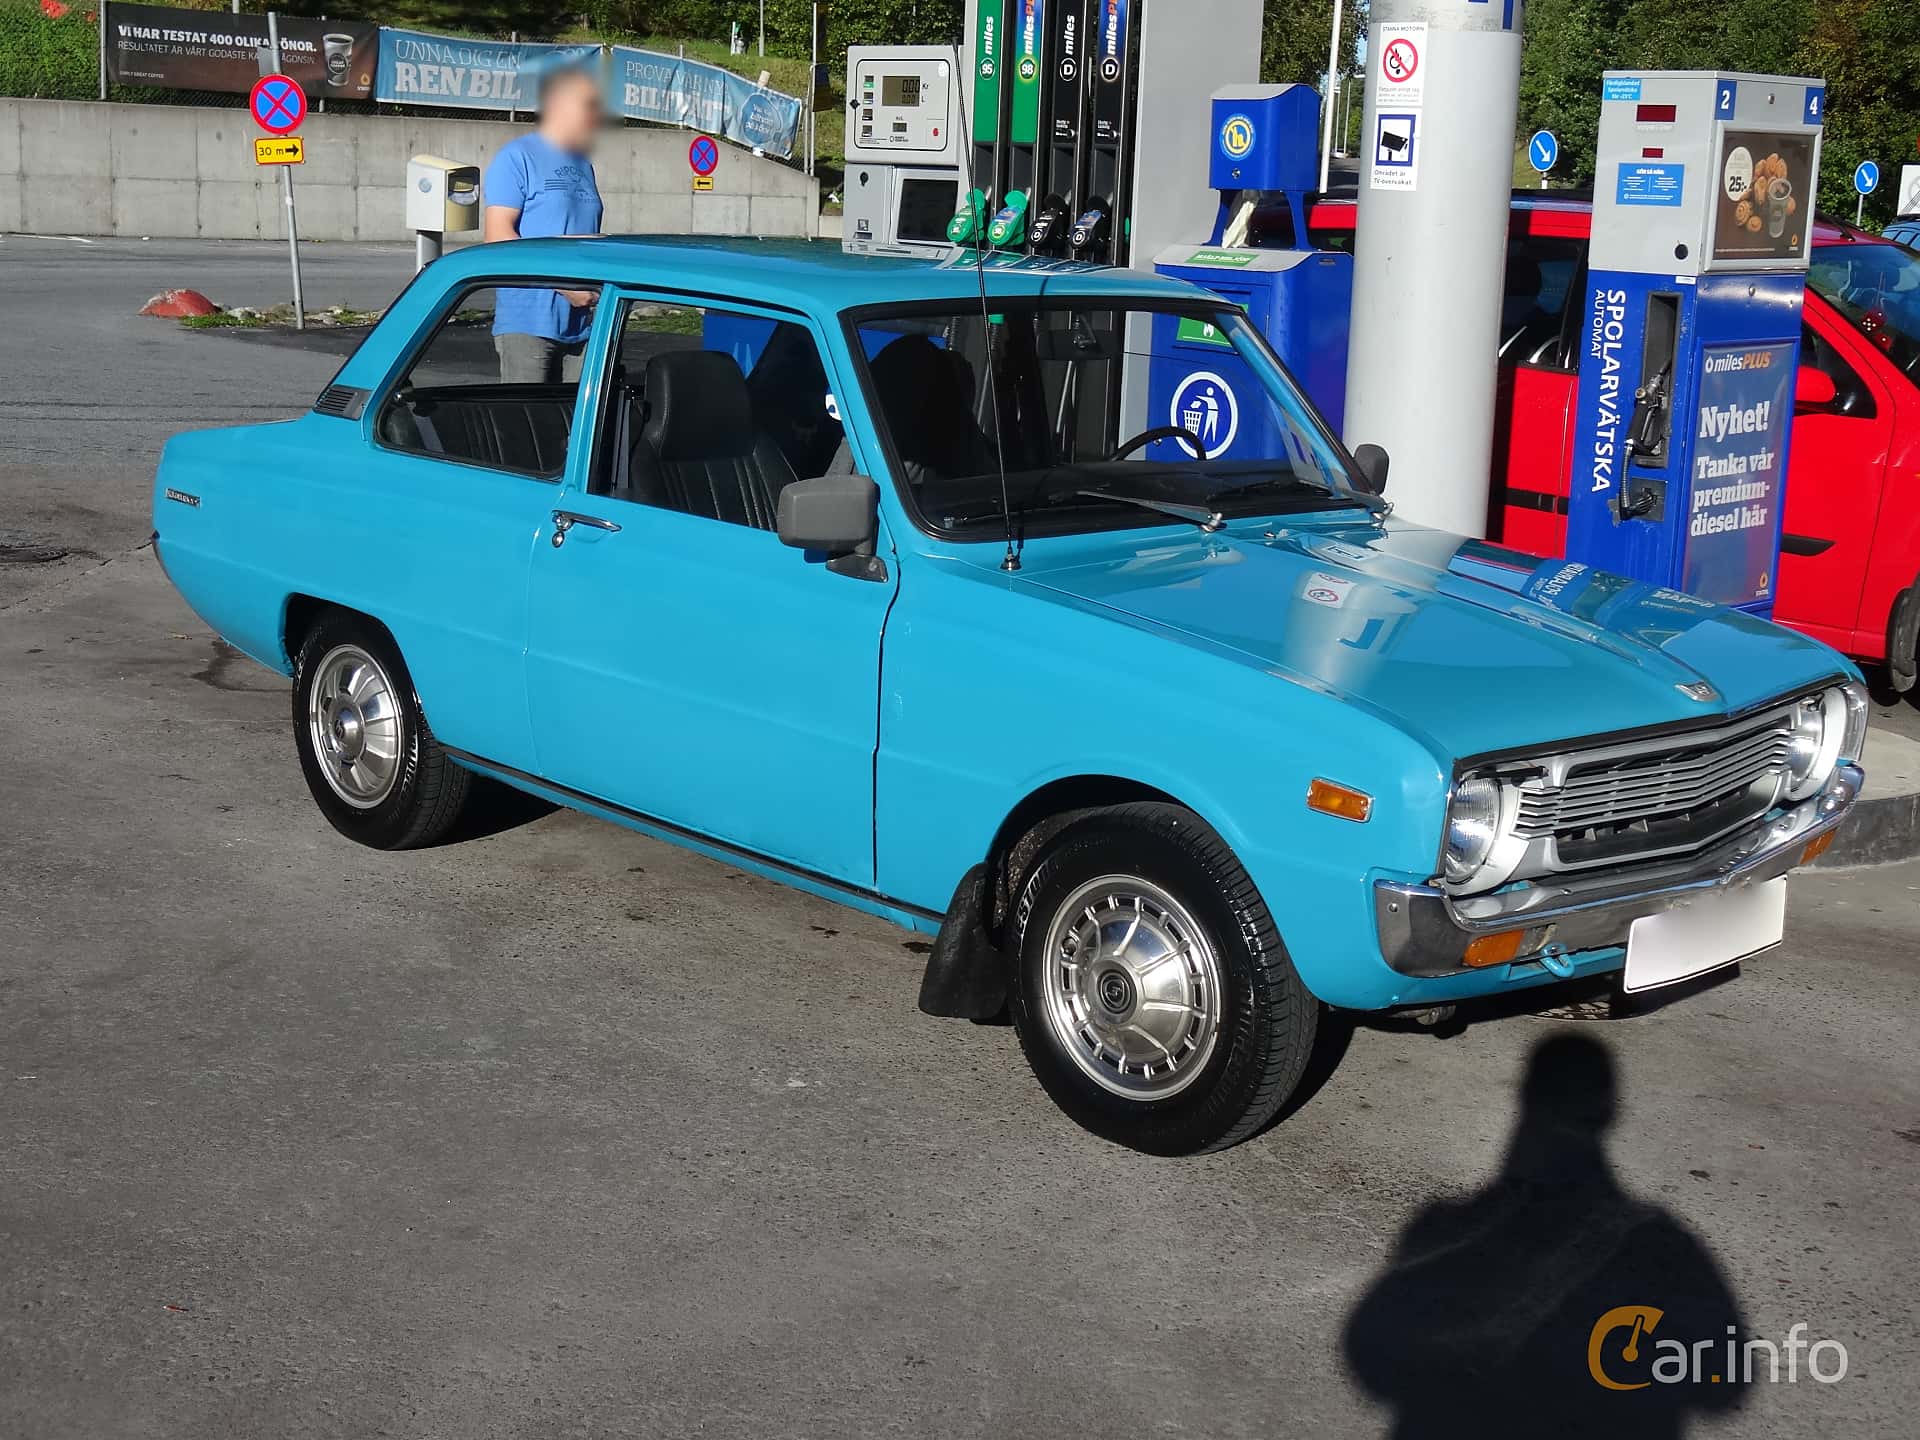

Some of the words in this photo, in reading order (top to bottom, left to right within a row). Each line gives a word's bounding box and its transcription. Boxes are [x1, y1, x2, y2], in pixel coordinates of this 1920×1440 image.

[118, 25, 132, 37] VI
[132, 27, 160, 40] HAR
[162, 29, 208, 43] TESTAT
[209, 33, 233, 45] 400
[280, 38, 317, 52] ÖNOR.
[983, 16, 994, 55] miles
[1064, 15, 1075, 55] miles
[118, 41, 169, 54] RESULTATET
[186, 46, 206, 57] VÅRT
[208, 48, 246, 60] GODASTE
[396, 40, 456, 64] UNNA
[459, 48, 492, 67] DIG
[395, 62, 466, 97] REN
[466, 68, 521, 100] BIL
[981, 63, 993, 75] 95
[1021, 64, 1034, 75] 98
[1063, 65, 1074, 76] D
[1105, 64, 1116, 76] D
[1721, 90, 1731, 110] 2
[1809, 96, 1818, 115] 4
[258, 147, 272, 156] 30
[275, 148, 284, 156] m
[1591, 289, 1606, 359] AUTOMAT
[1713, 352, 1771, 372] milesPLUS
[1592, 289, 1626, 492] SPOLARVÄTSKA
[1699, 400, 1770, 443] Nyhet!
[1697, 453, 1747, 479] Tanka
[1749, 447, 1775, 473] vår
[1692, 478, 1771, 513] premium-
[1690, 508, 1739, 537] diesel
[1739, 504, 1768, 530] här
